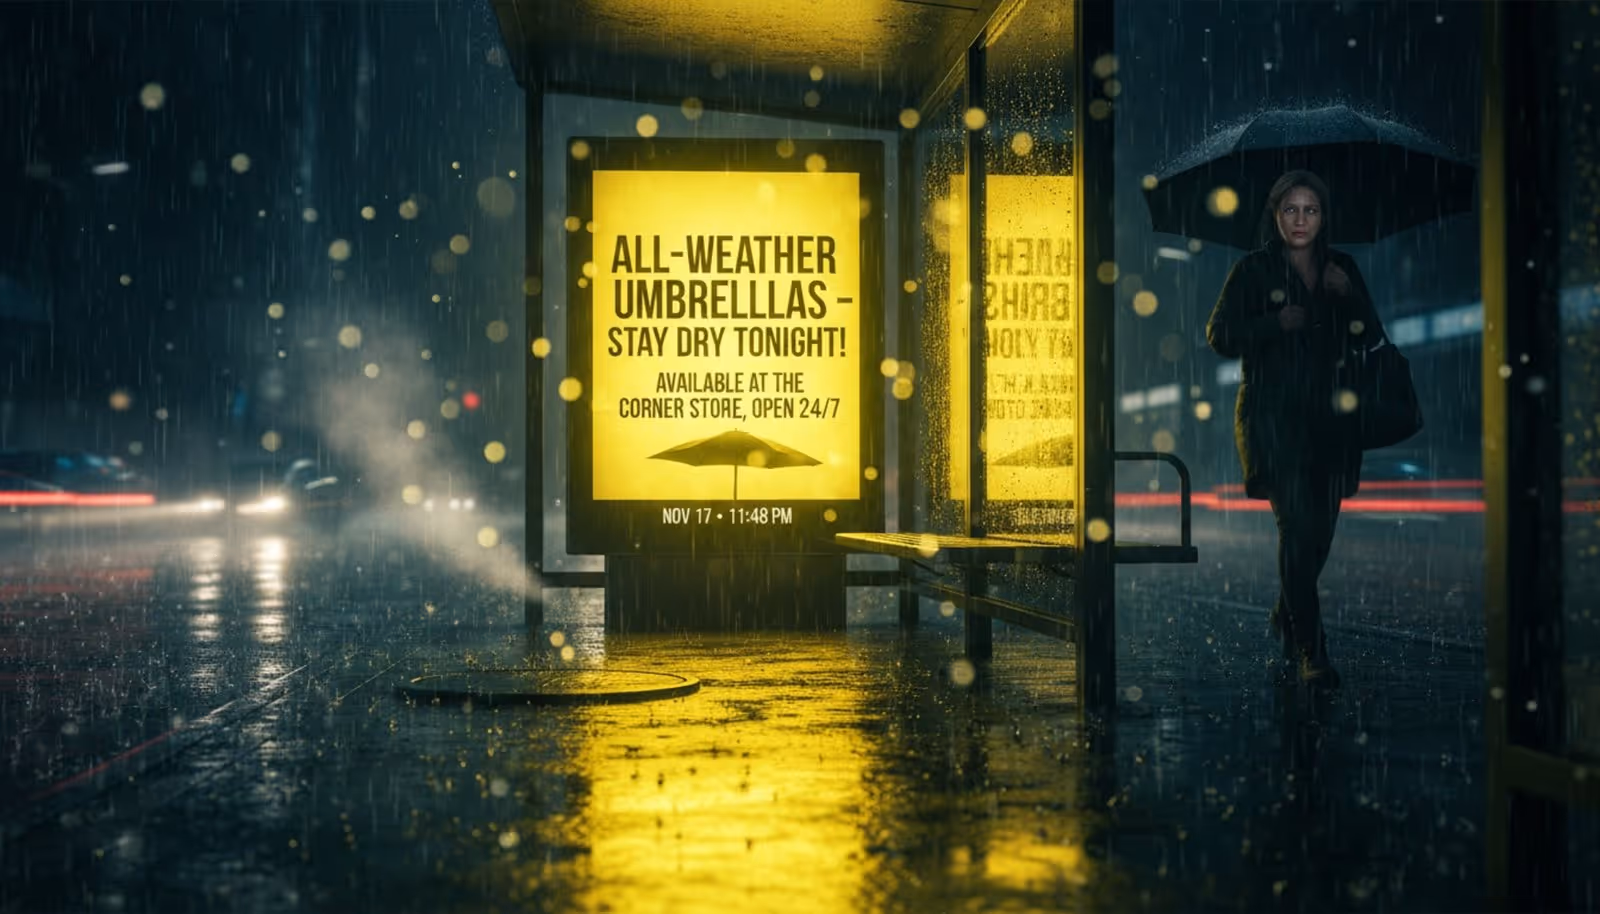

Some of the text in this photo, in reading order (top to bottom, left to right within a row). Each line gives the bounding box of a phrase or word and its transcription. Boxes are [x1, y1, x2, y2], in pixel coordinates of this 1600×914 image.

[611, 234, 837, 274] ALL-WEATHER
[614, 279, 827, 320] UMBRELLLAS
[607, 326, 846, 358] STAY DRY TONIGHT!
[656, 372, 805, 393] AVAILABLE AT THE
[619, 397, 841, 422] CORNER STORE, OPEN 24/7
[662, 507, 691, 525] NOV
[695, 507, 712, 525] 17
[729, 507, 769, 525] 11:48
[771, 507, 793, 525] PM
